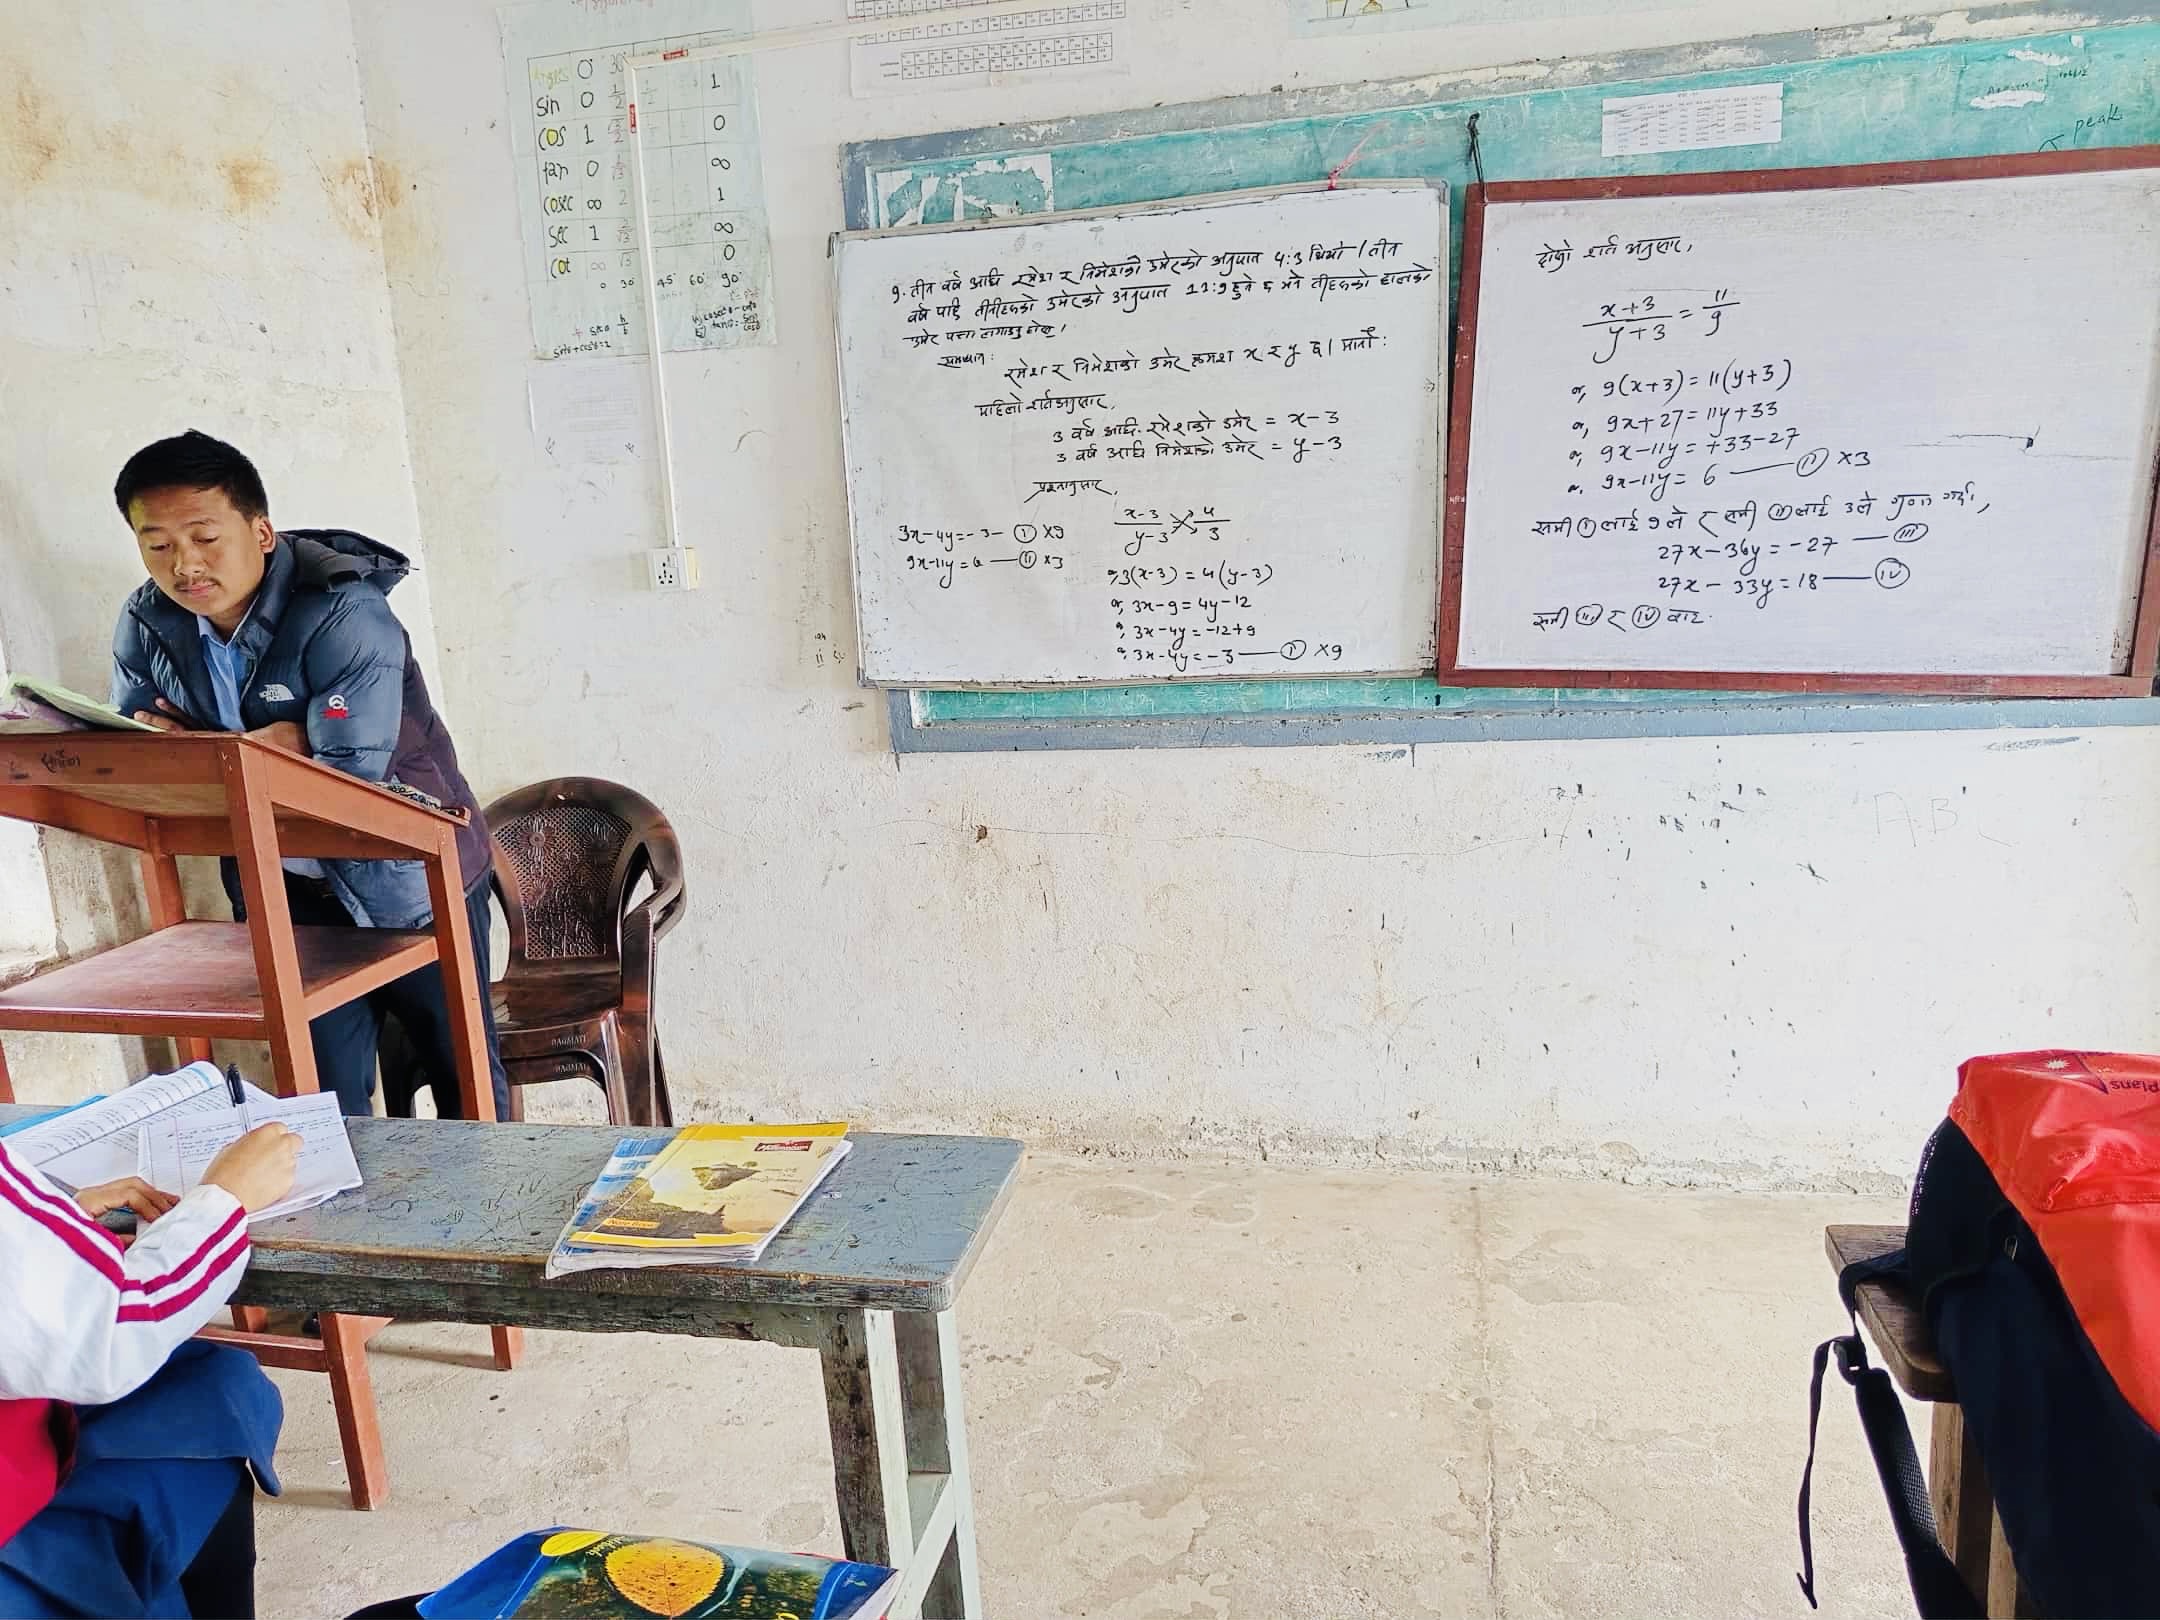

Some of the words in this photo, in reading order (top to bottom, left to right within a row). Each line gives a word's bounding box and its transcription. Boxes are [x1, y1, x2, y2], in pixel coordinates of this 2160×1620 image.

[711, 72, 721, 89] 1
[581, 91, 594, 108] 0
[713, 114, 726, 131] 0
